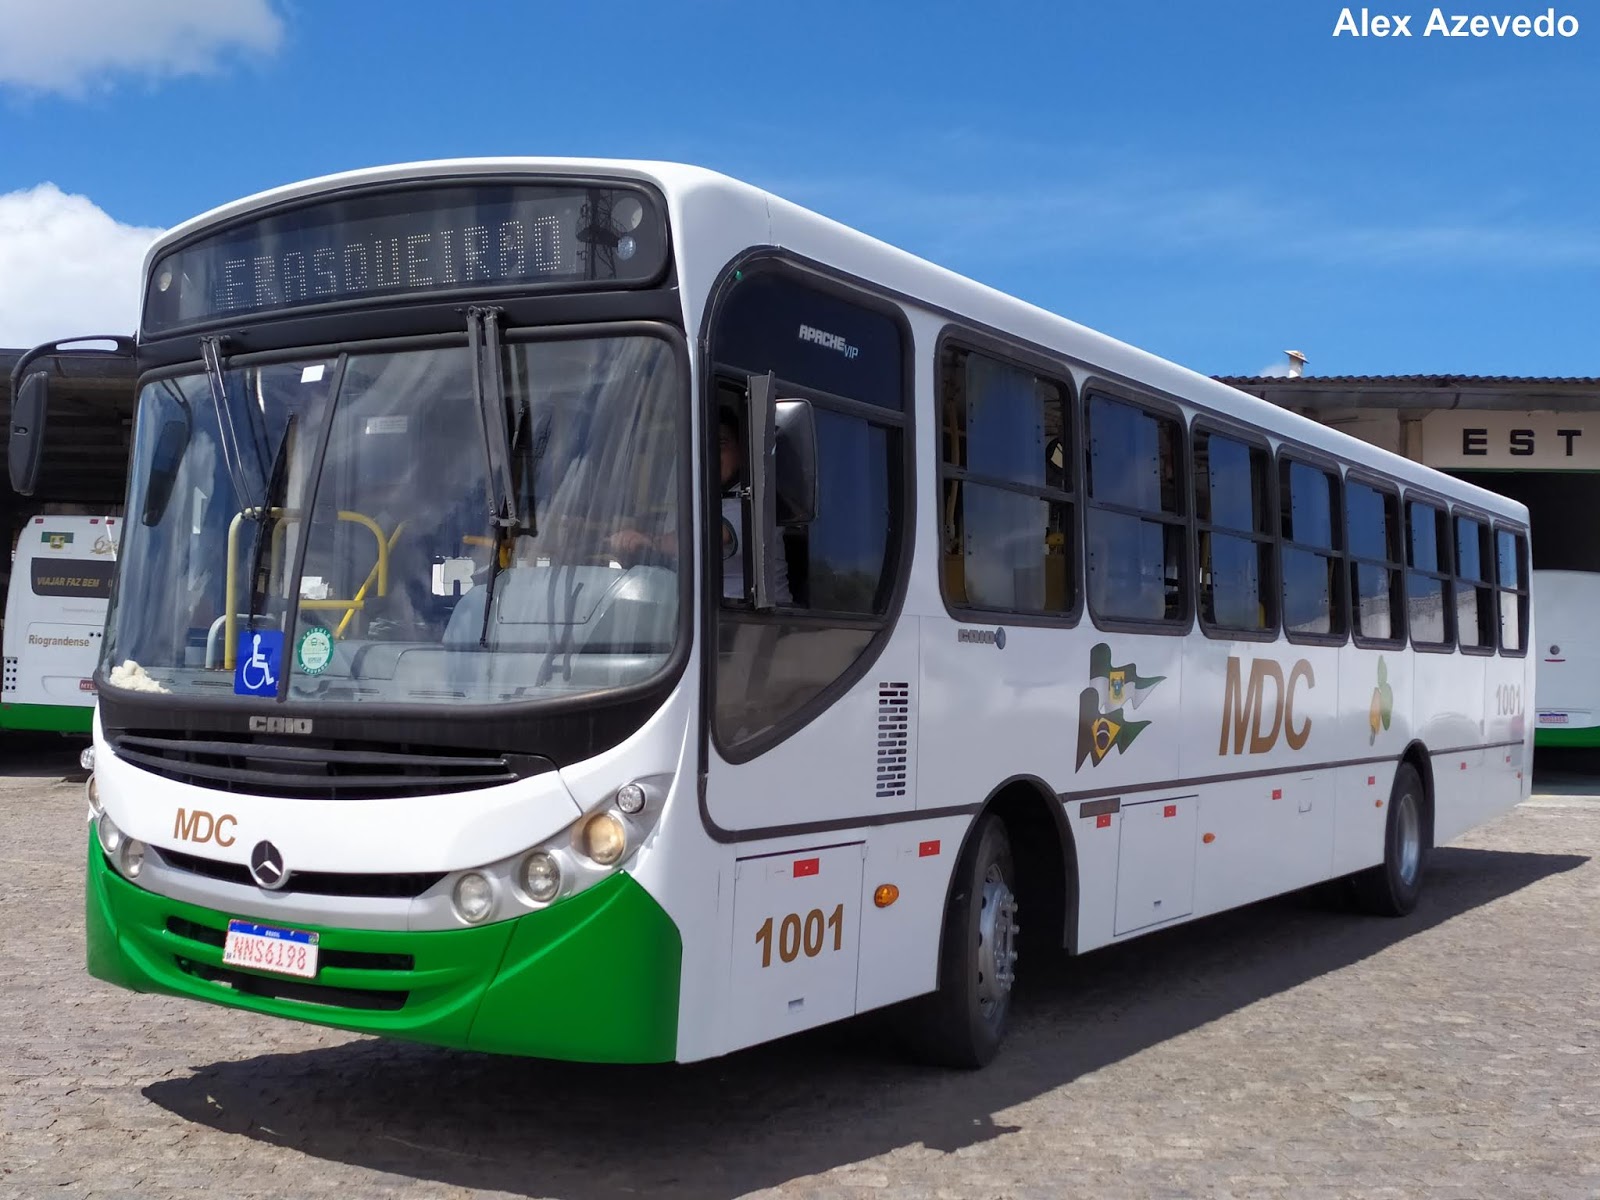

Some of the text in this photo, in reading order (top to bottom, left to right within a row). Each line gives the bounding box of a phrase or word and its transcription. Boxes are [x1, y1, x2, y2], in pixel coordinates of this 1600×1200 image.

[799, 324, 859, 359] APACHE VIP
[37, 577, 65, 586] VIAJAR
[66, 577, 81, 587] FAZ
[82, 578, 100, 588] BEM
[28, 634, 90, 648] Riograndense
[1219, 656, 1315, 756] MDC
[1496, 683, 1521, 716] 1001
[249, 715, 313, 734] CAIO
[173, 808, 238, 847] MDC
[755, 903, 844, 968] 1001
[233, 936, 307, 970] NNS6198
